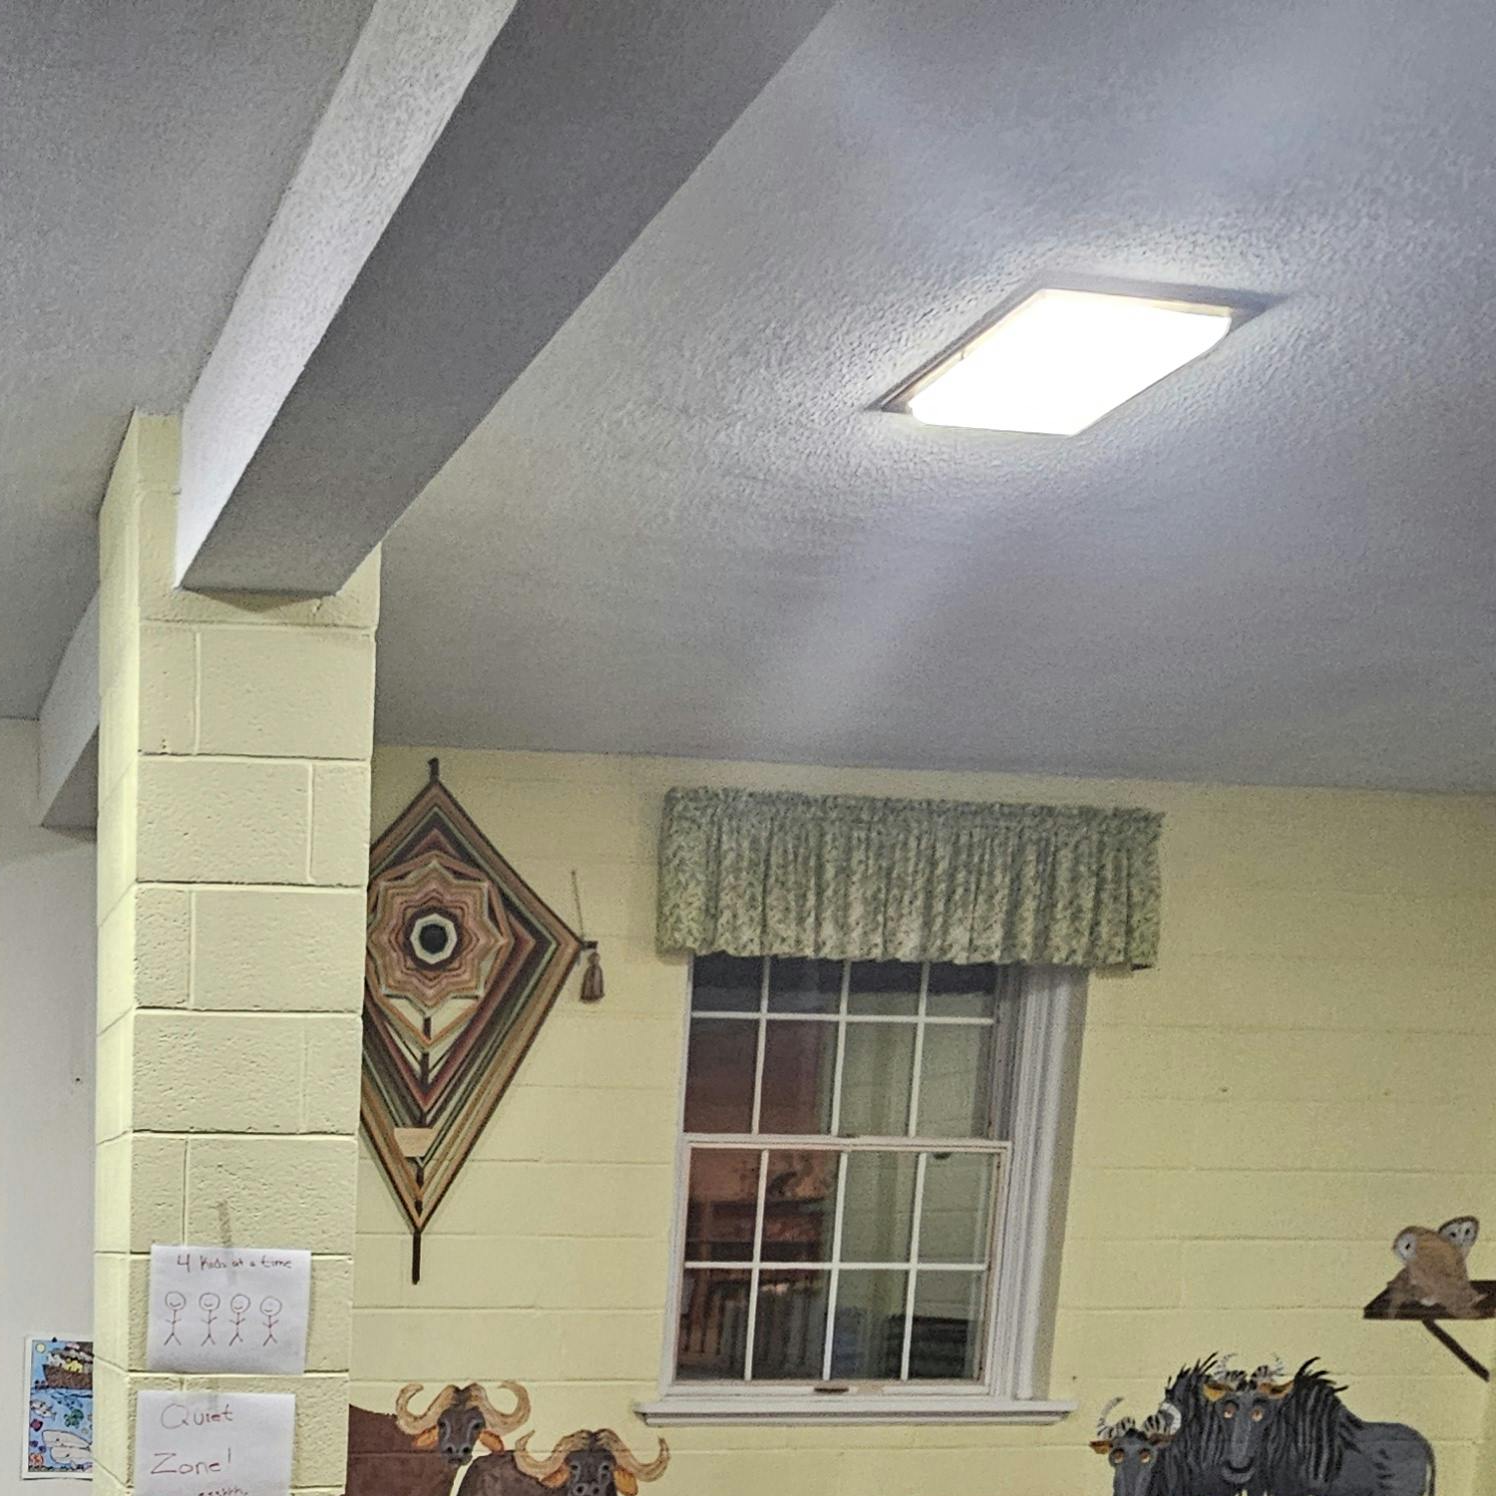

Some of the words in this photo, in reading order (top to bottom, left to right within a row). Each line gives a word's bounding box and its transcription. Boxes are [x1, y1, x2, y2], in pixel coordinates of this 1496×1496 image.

[177, 1254, 190, 1273] 4
[261, 1254, 293, 1269] time
[160, 1403, 234, 1430] Quiet
